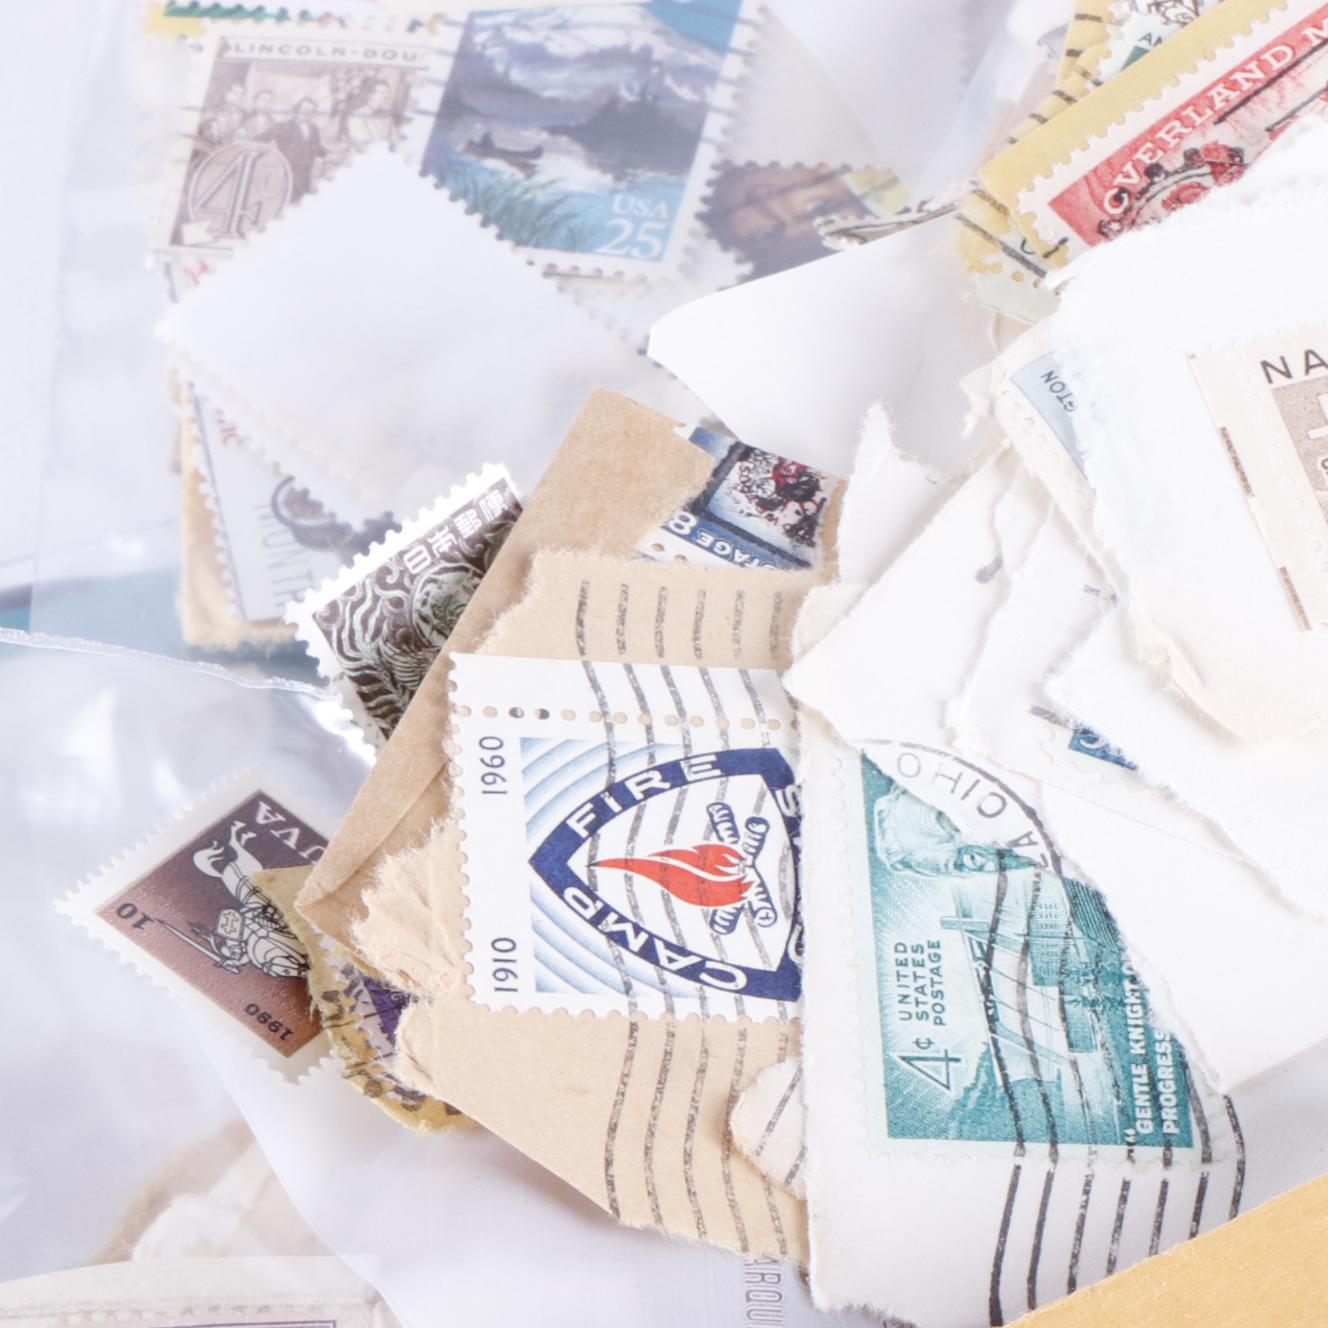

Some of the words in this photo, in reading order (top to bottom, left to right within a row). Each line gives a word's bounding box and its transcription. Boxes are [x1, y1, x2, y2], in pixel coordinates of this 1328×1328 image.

[1103, 43, 1296, 214] OVERLAND
[597, 218, 668, 260] 25
[612, 195, 671, 219] USA
[402, 489, 509, 575] 日本郵便
[666, 511, 698, 536] 8
[478, 735, 508, 796] 1960
[565, 754, 722, 838] FIRE
[898, 752, 1008, 819] OHIO
[115, 901, 158, 932] 10
[562, 887, 749, 991] CAMP
[490, 937, 520, 993] 1910
[894, 941, 914, 1022] UNITED
[910, 943, 931, 1022] STATES
[928, 939, 947, 1027] POSTAGE
[244, 1002, 296, 1042] 1990
